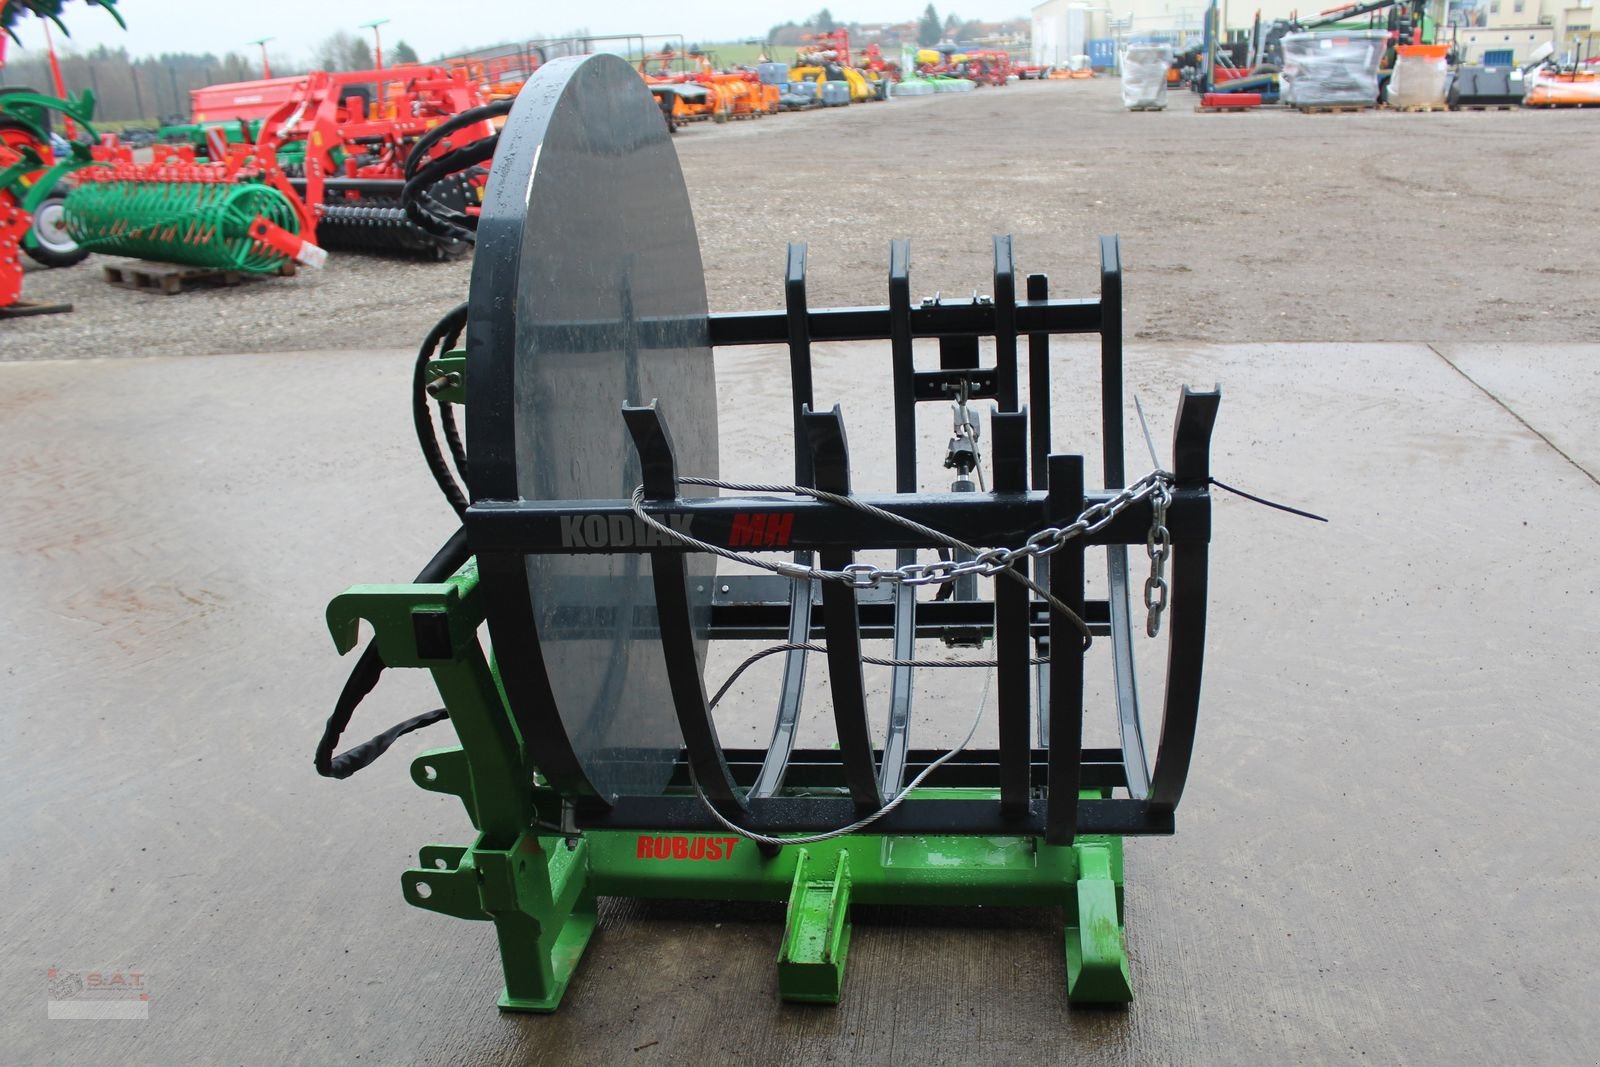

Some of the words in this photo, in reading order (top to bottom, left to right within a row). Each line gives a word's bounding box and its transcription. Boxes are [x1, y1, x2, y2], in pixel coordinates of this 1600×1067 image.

[559, 513, 695, 548] KODIAK
[728, 512, 795, 546] MH
[636, 835, 740, 860] ROBUST
